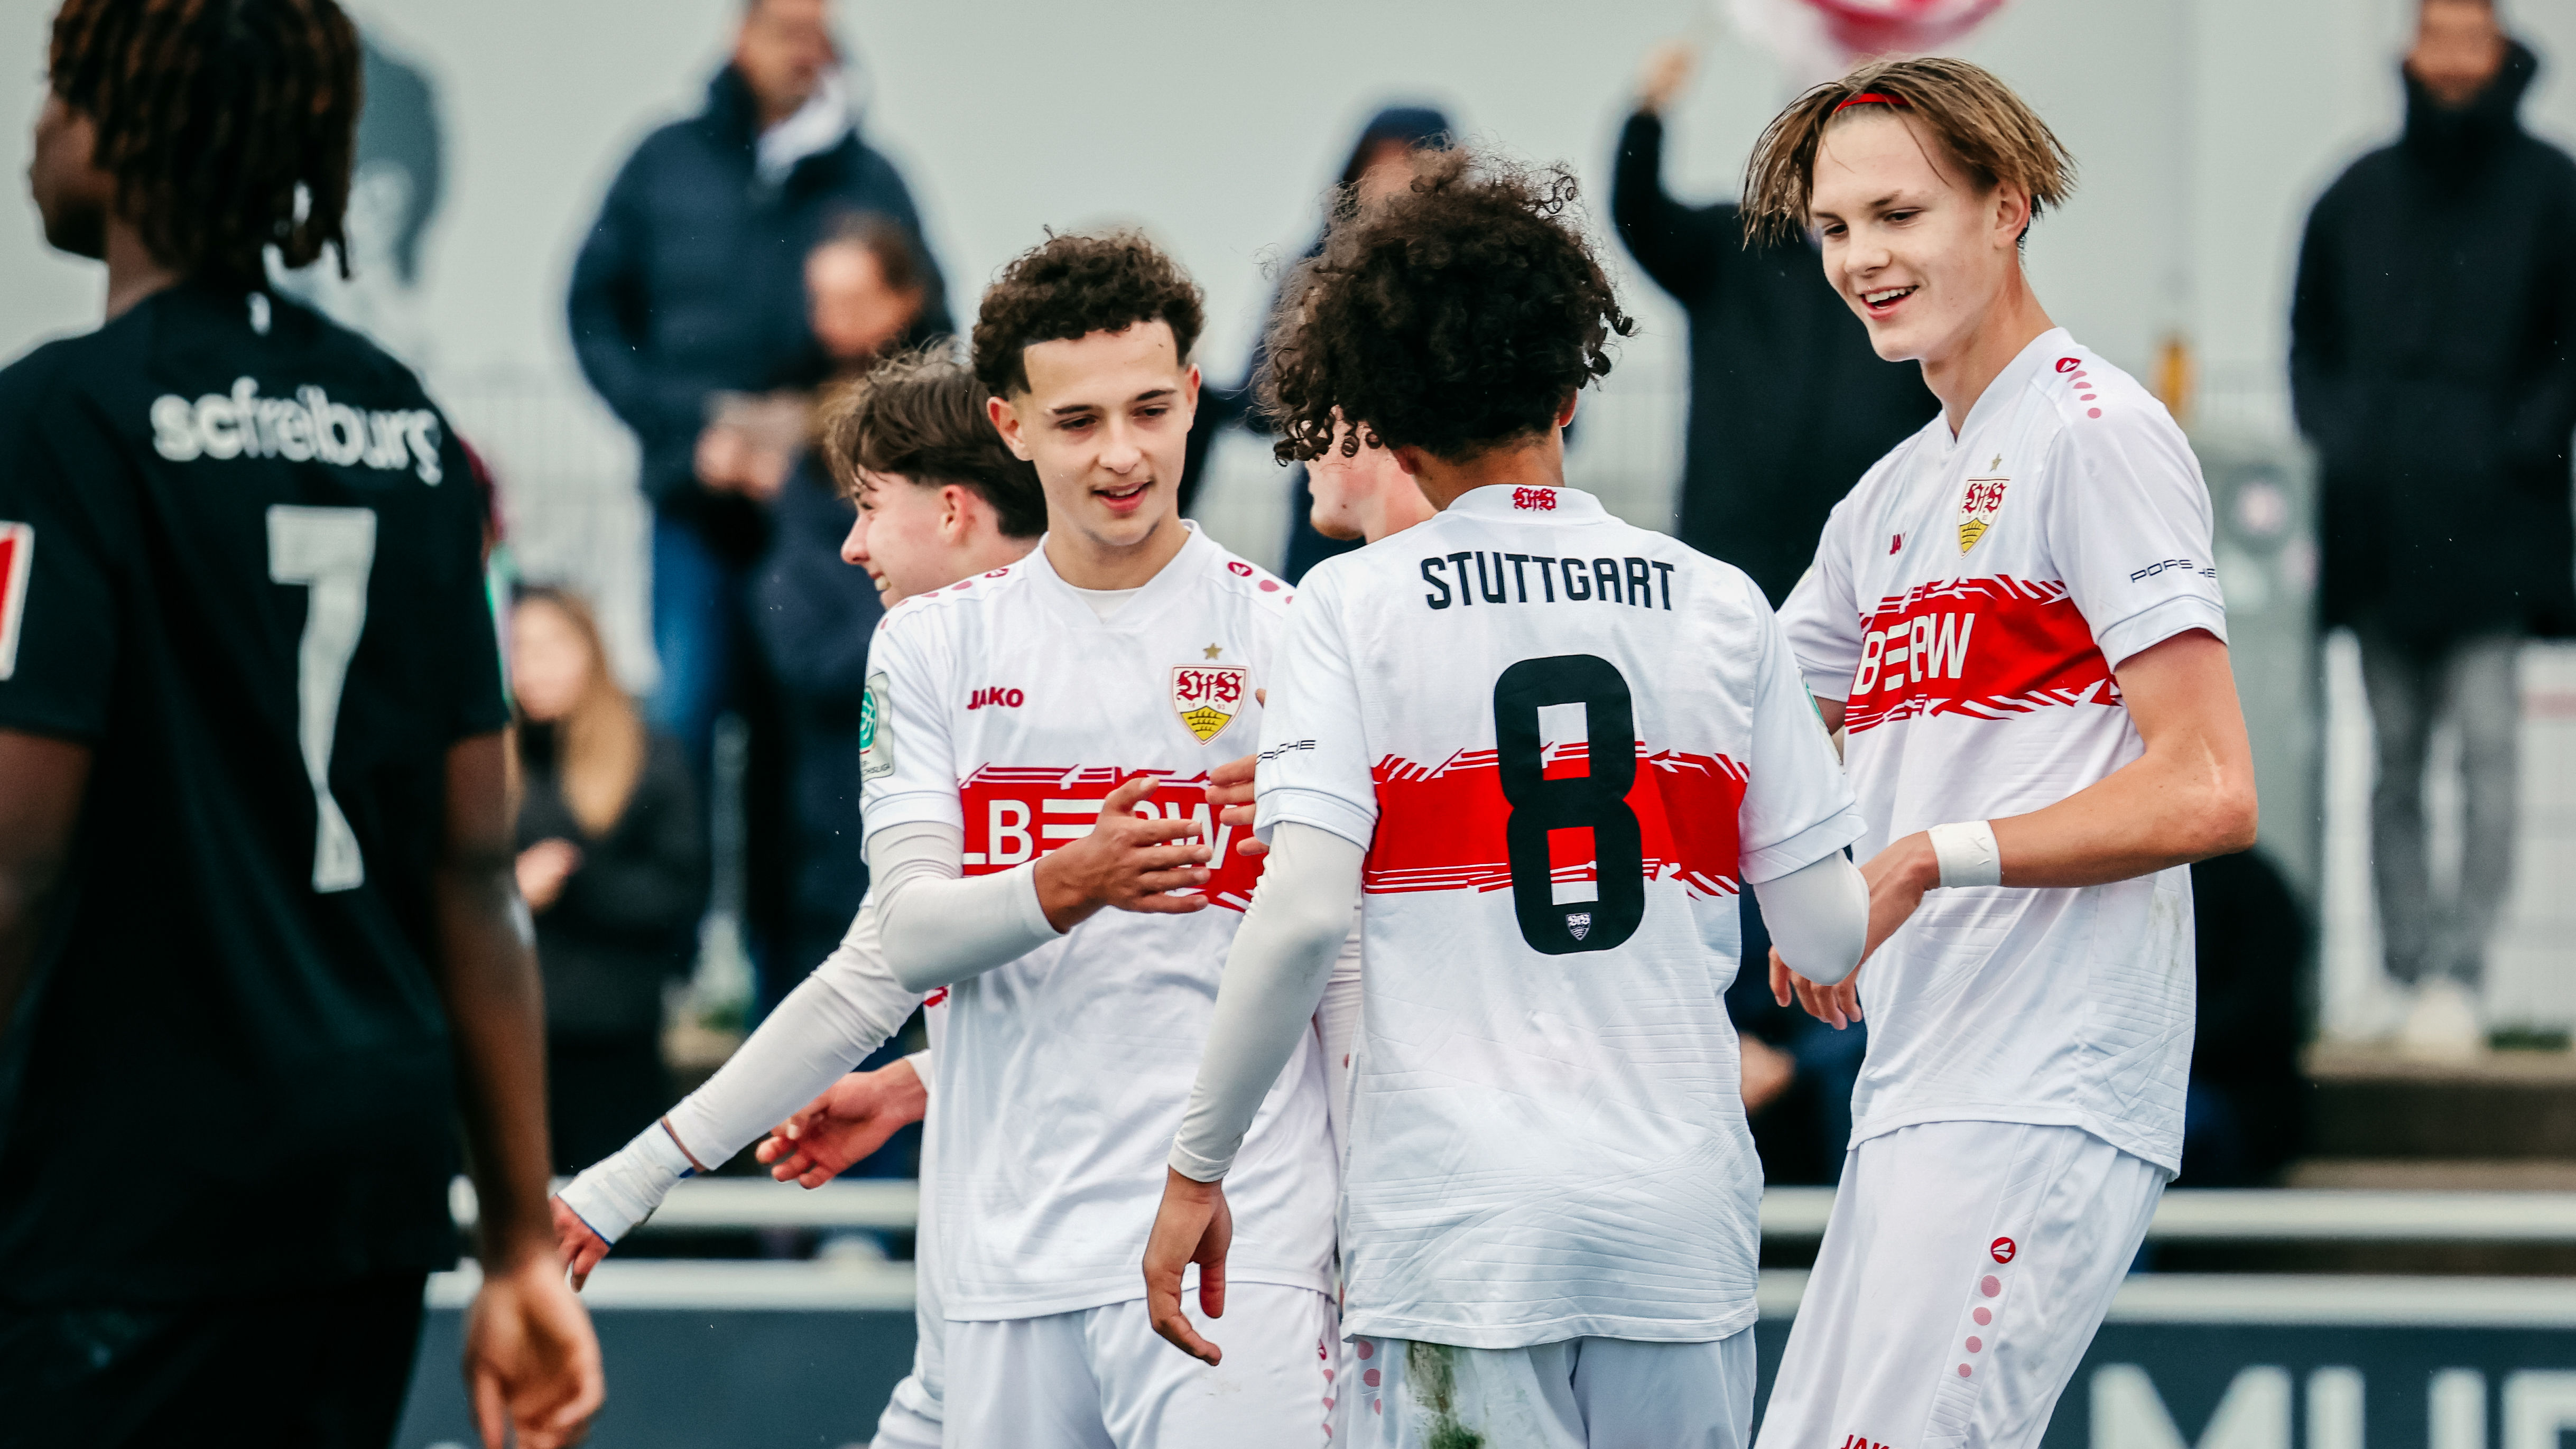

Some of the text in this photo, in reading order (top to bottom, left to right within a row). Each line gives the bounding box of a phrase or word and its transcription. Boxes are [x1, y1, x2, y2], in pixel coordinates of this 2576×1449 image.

[1420, 551, 1674, 611] STUTTGART
[265, 504, 377, 893] 7
[967, 686, 1024, 711] JAKO
[1176, 670, 1242, 703] VfB
[1494, 654, 1645, 955] 8
